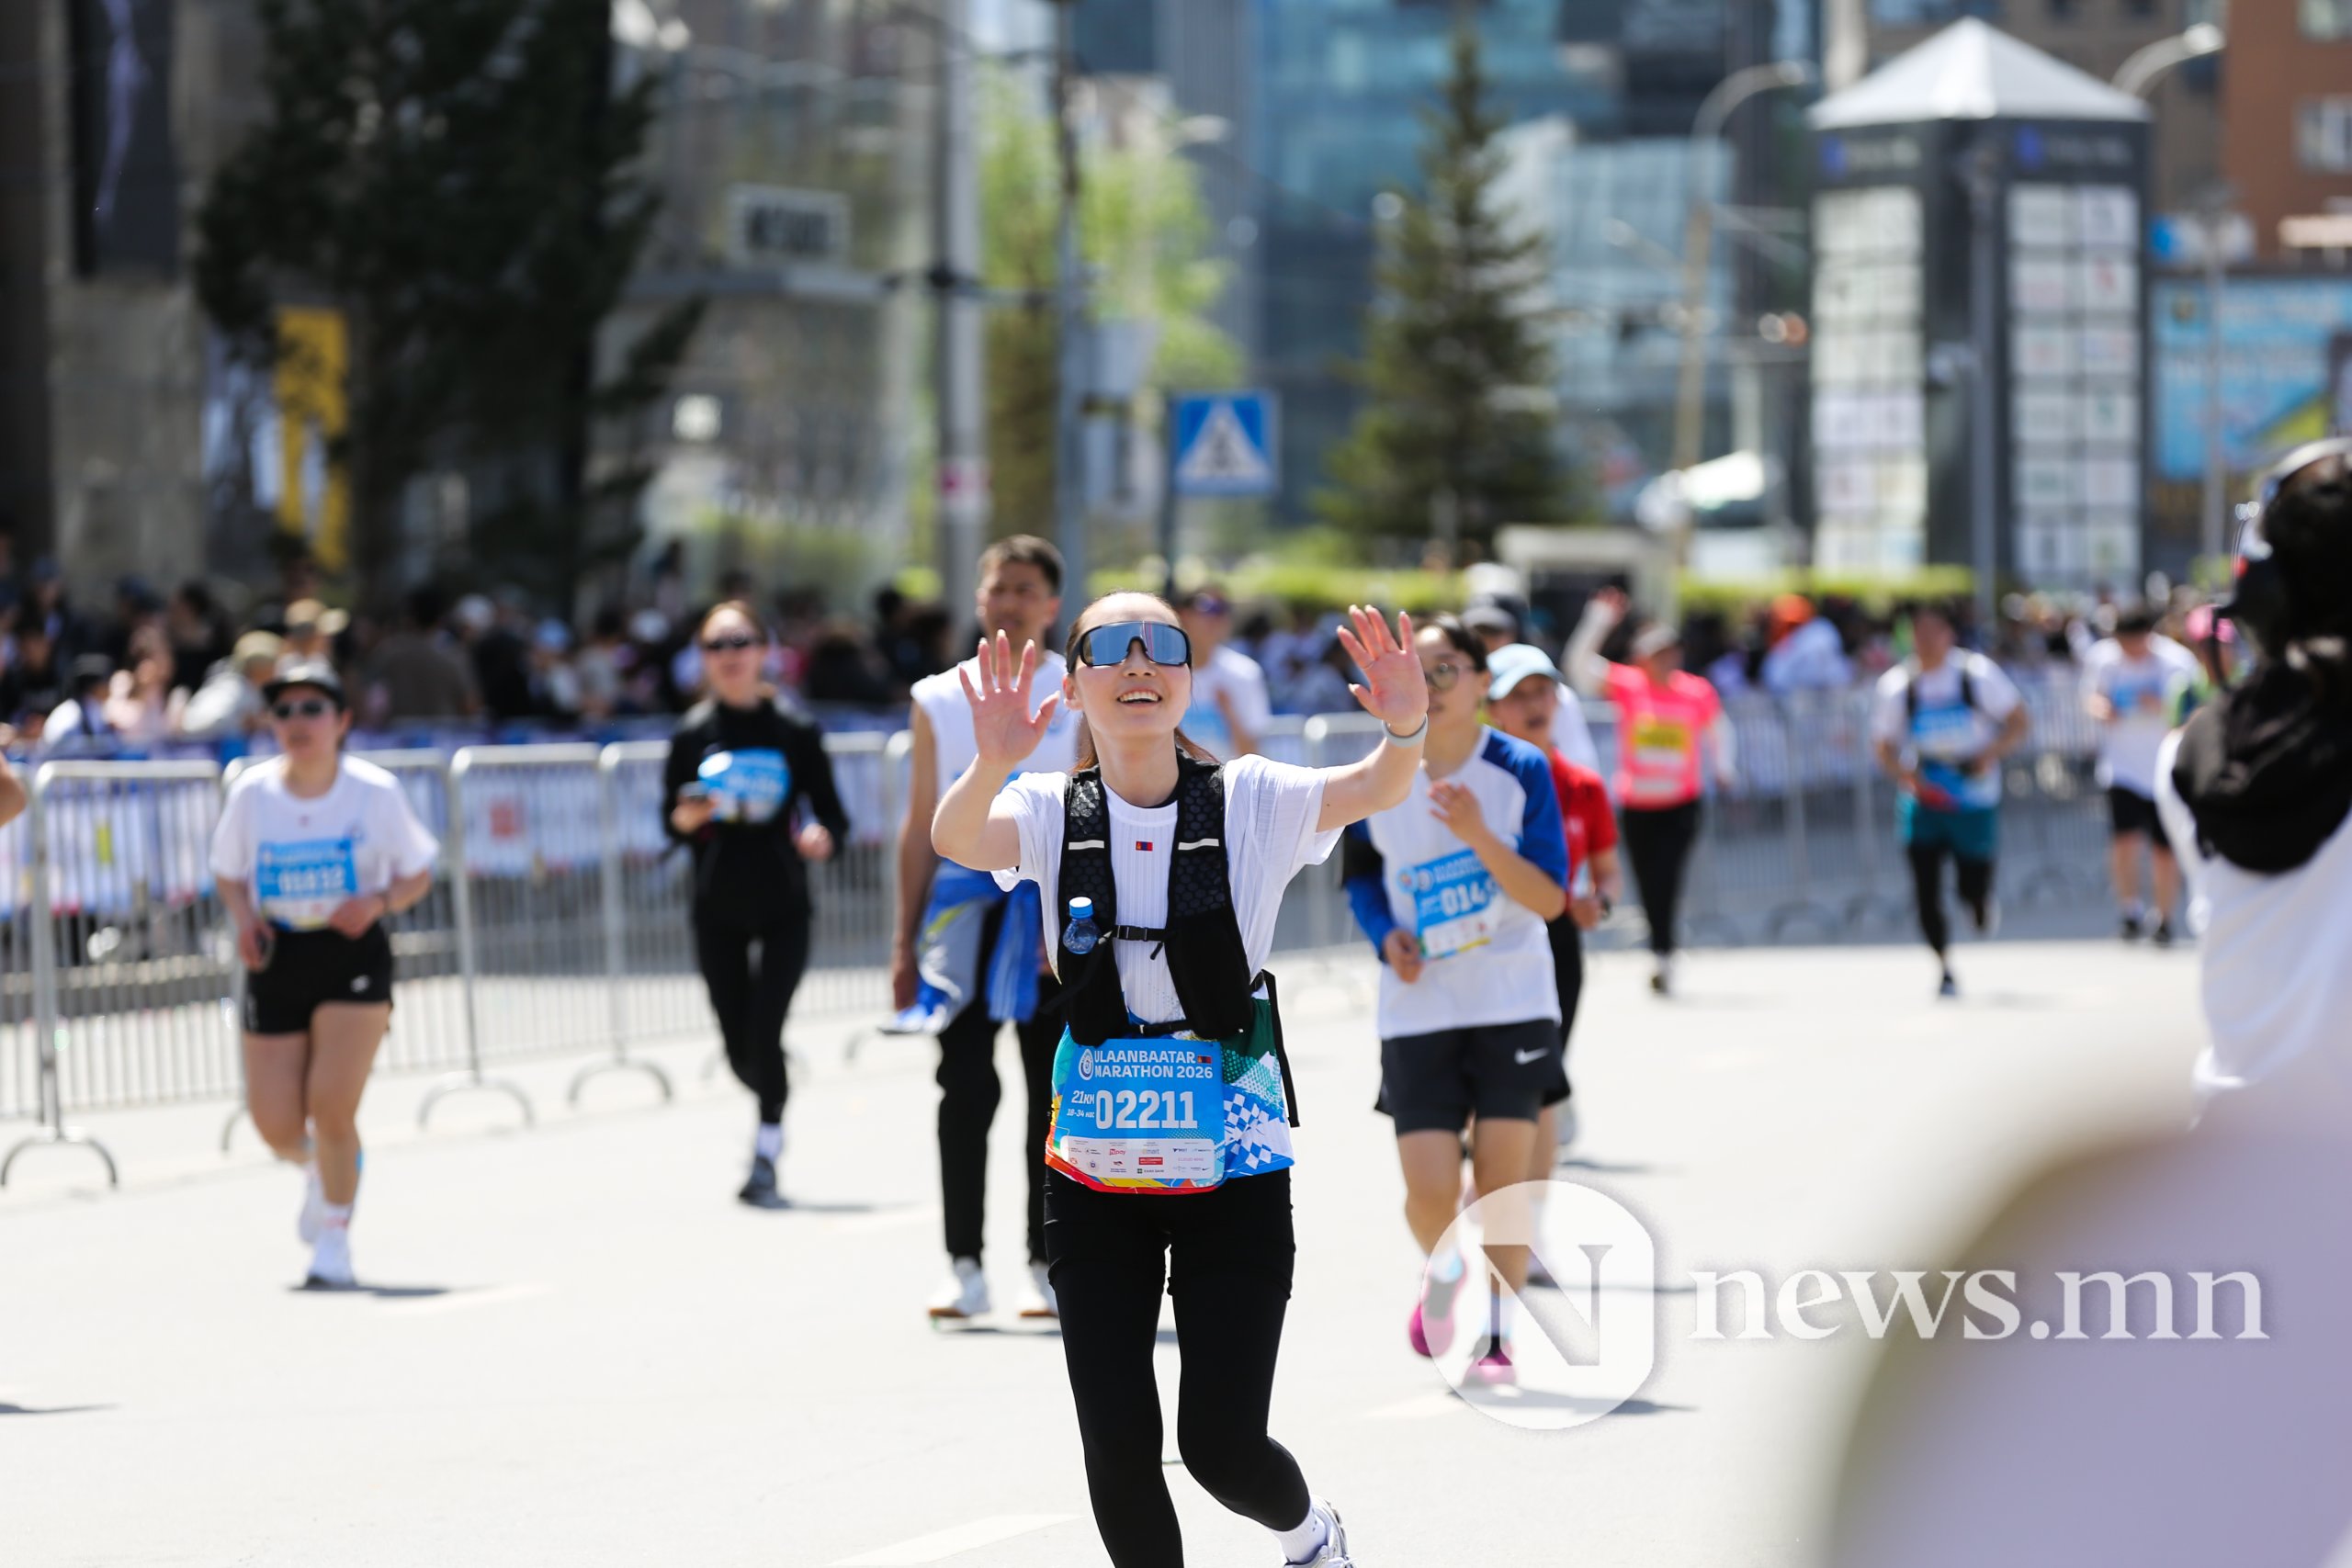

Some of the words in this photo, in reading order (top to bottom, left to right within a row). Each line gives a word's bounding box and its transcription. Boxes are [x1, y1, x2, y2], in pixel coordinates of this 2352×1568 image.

[1094, 1050, 1196, 1064] ULAANBAATAR
[1094, 1065, 1173, 1078] MARATHON
[1176, 1066, 1214, 1079] 2026
[1067, 1108, 1084, 1118] 18-34
[1095, 1089, 1198, 1130] 02211
